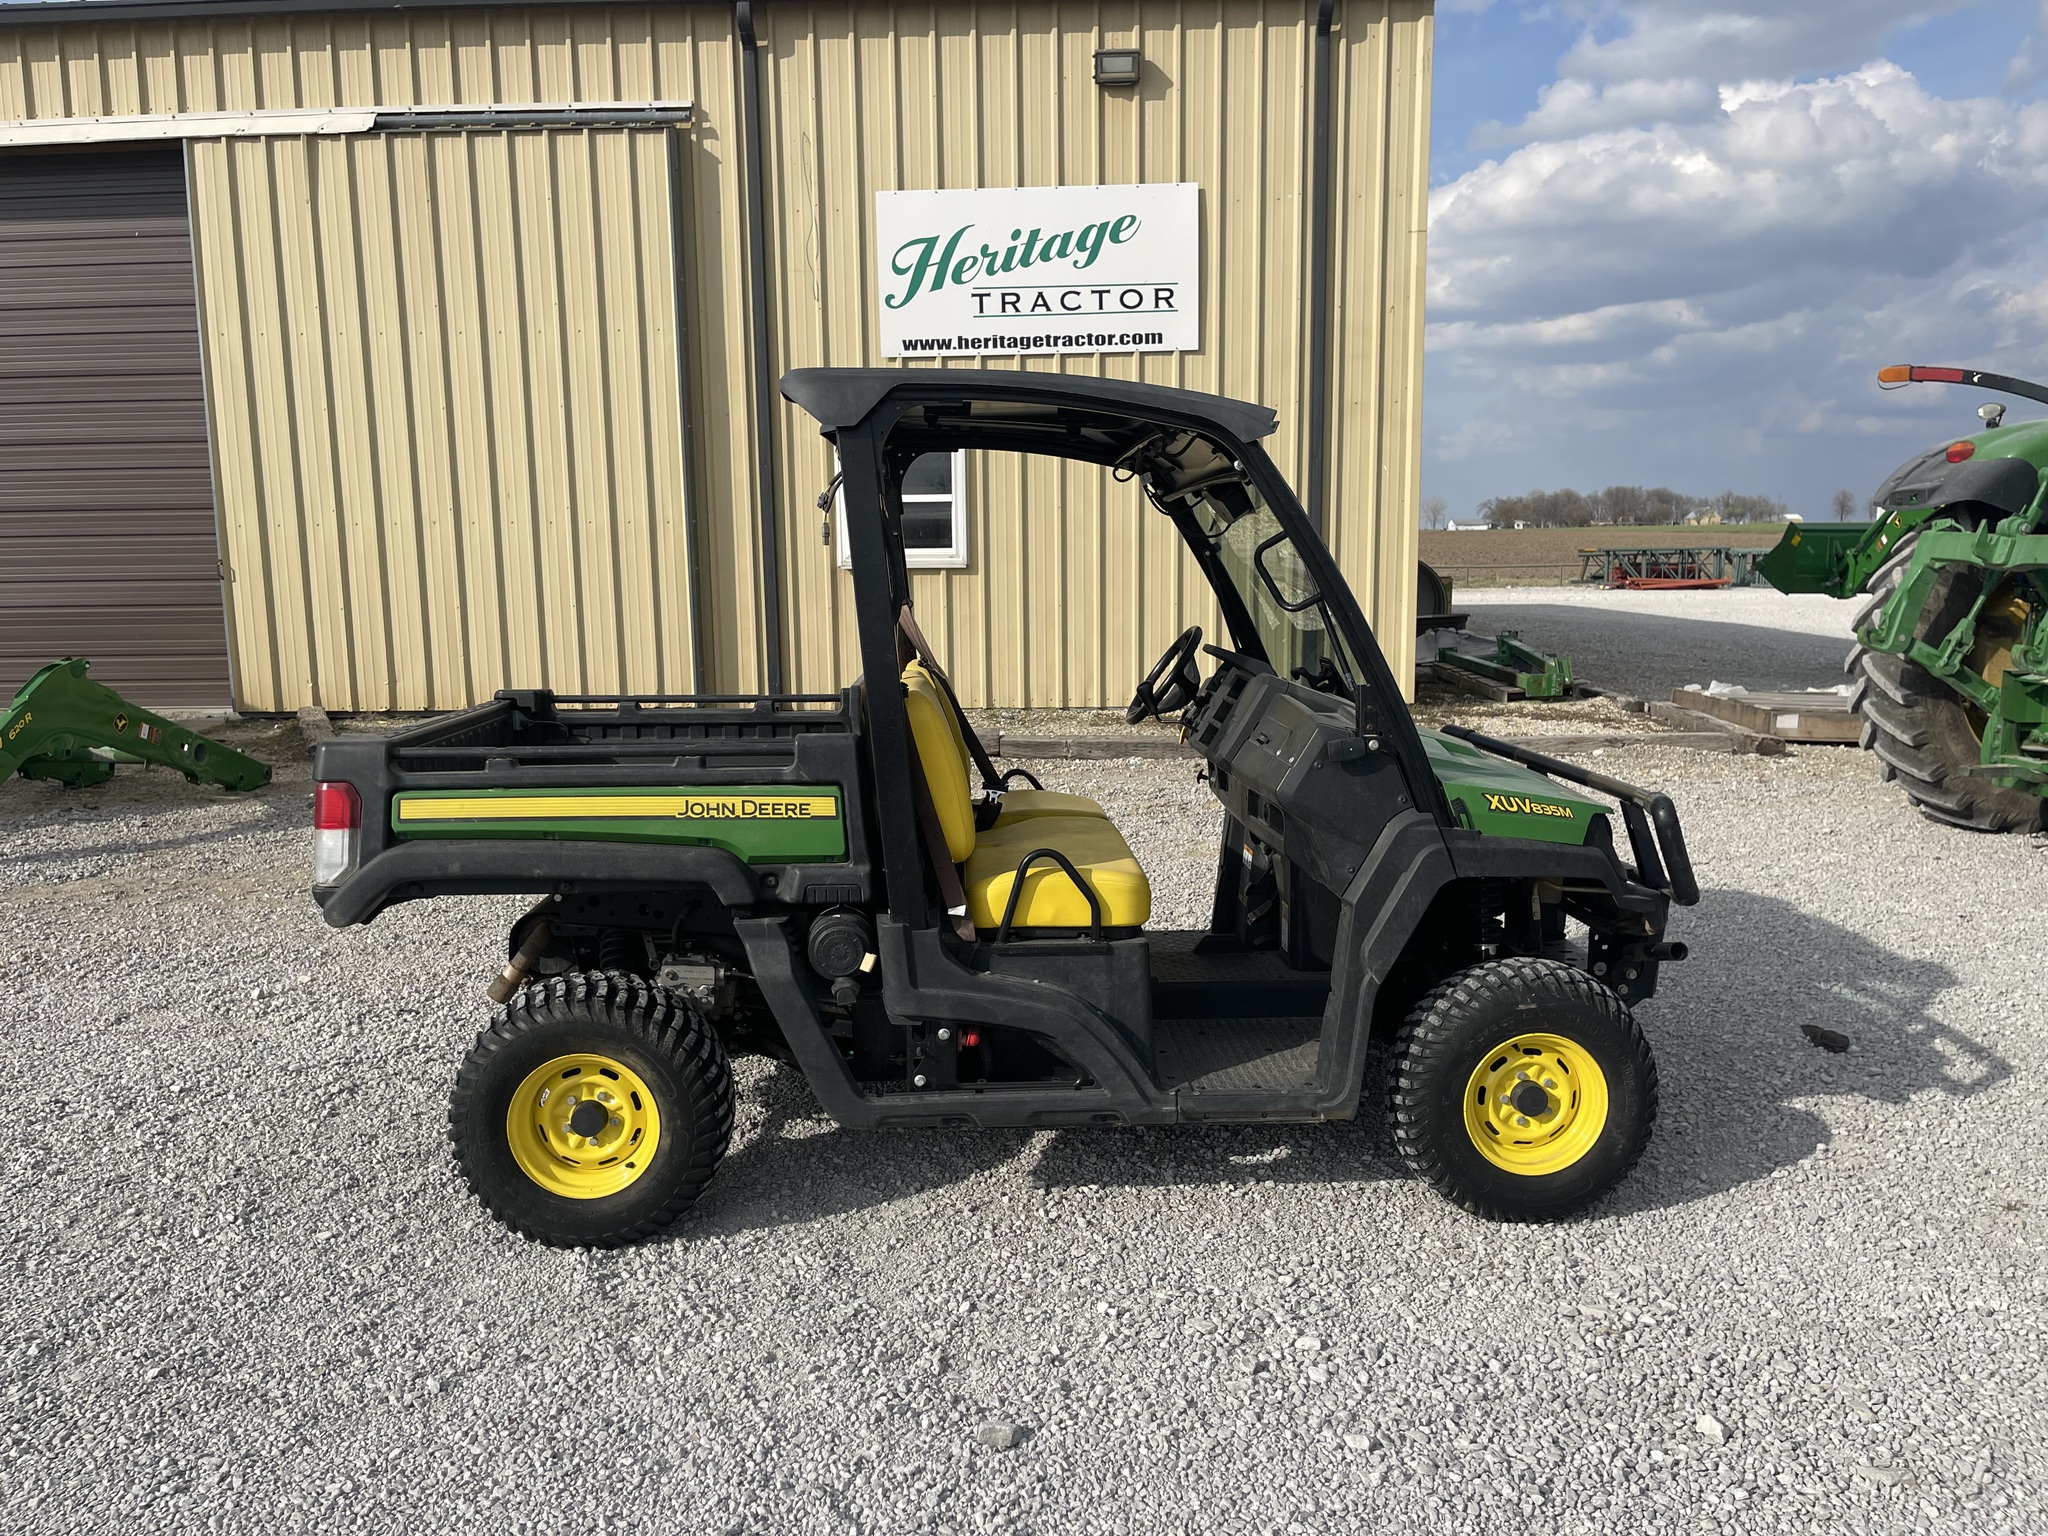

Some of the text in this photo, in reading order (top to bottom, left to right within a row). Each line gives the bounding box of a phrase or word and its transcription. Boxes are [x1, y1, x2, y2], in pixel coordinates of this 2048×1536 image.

[885, 214, 1142, 309] Heritage
[971, 287, 1175, 314] TRACTOR
[902, 331, 1164, 351] www.heritagetractor.com
[677, 799, 811, 816] JOHN DEERE
